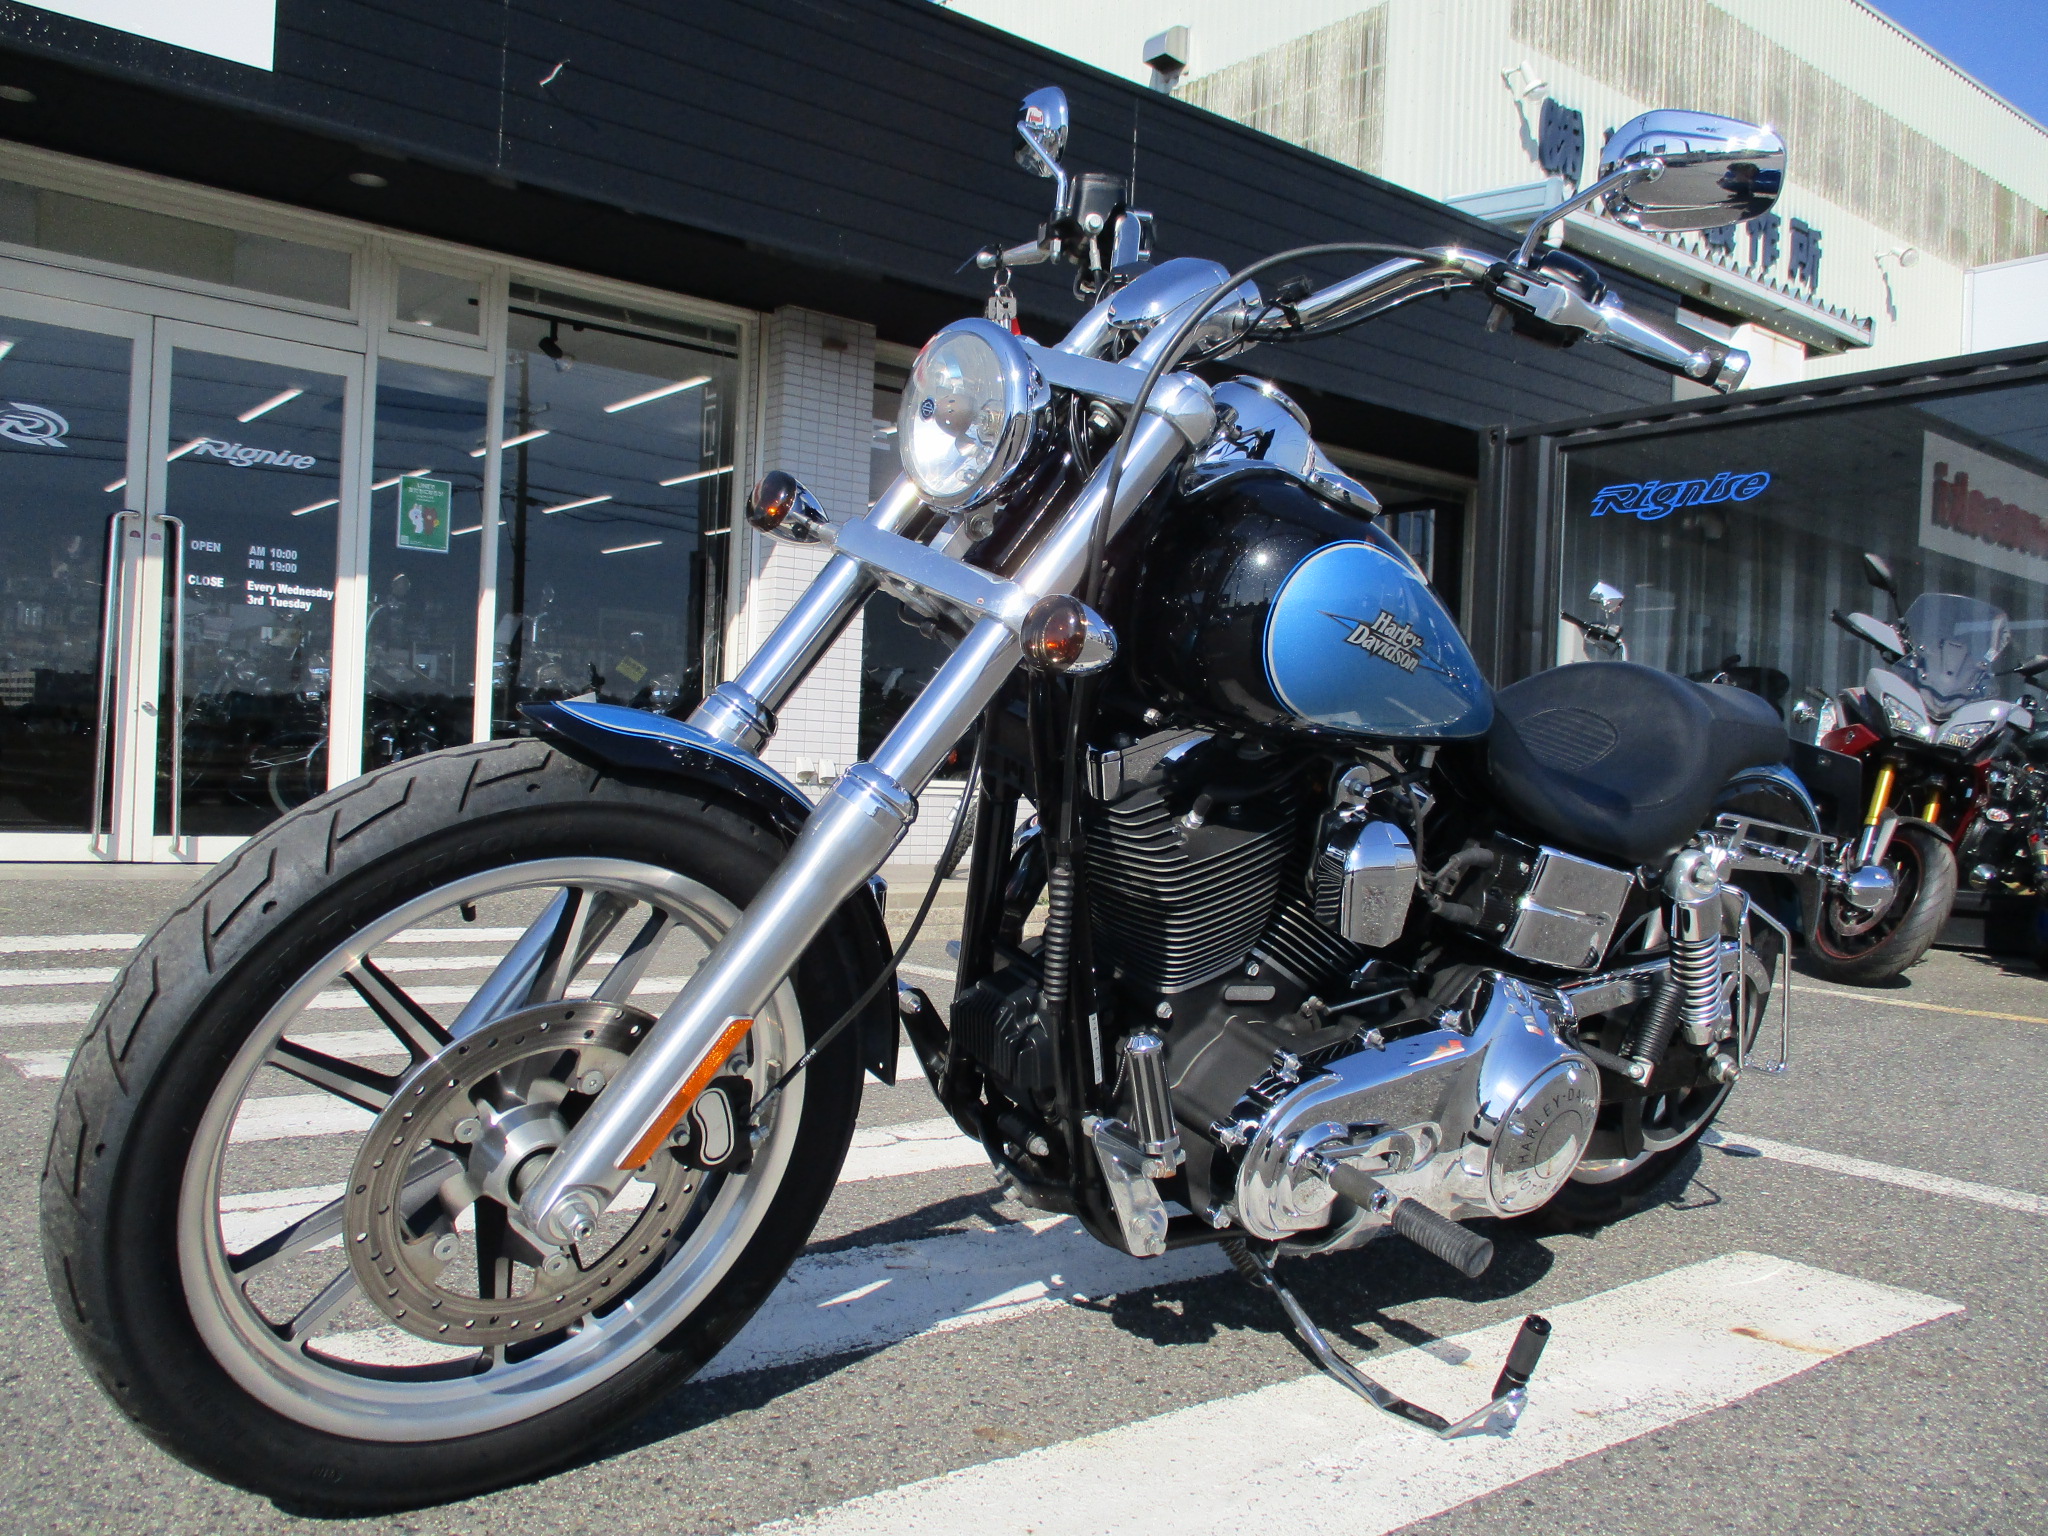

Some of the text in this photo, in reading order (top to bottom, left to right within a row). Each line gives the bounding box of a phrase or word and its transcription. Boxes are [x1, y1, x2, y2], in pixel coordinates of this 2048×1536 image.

[190, 540, 221, 553] OPEN
[249, 545, 298, 560] AM 10:00
[248, 558, 298, 573] PM 19:00
[187, 574, 224, 588] CLOSE
[247, 580, 335, 601] Every Wednesday
[247, 595, 312, 612] 3rd Tuesday
[1345, 624, 1420, 673] Davidson
